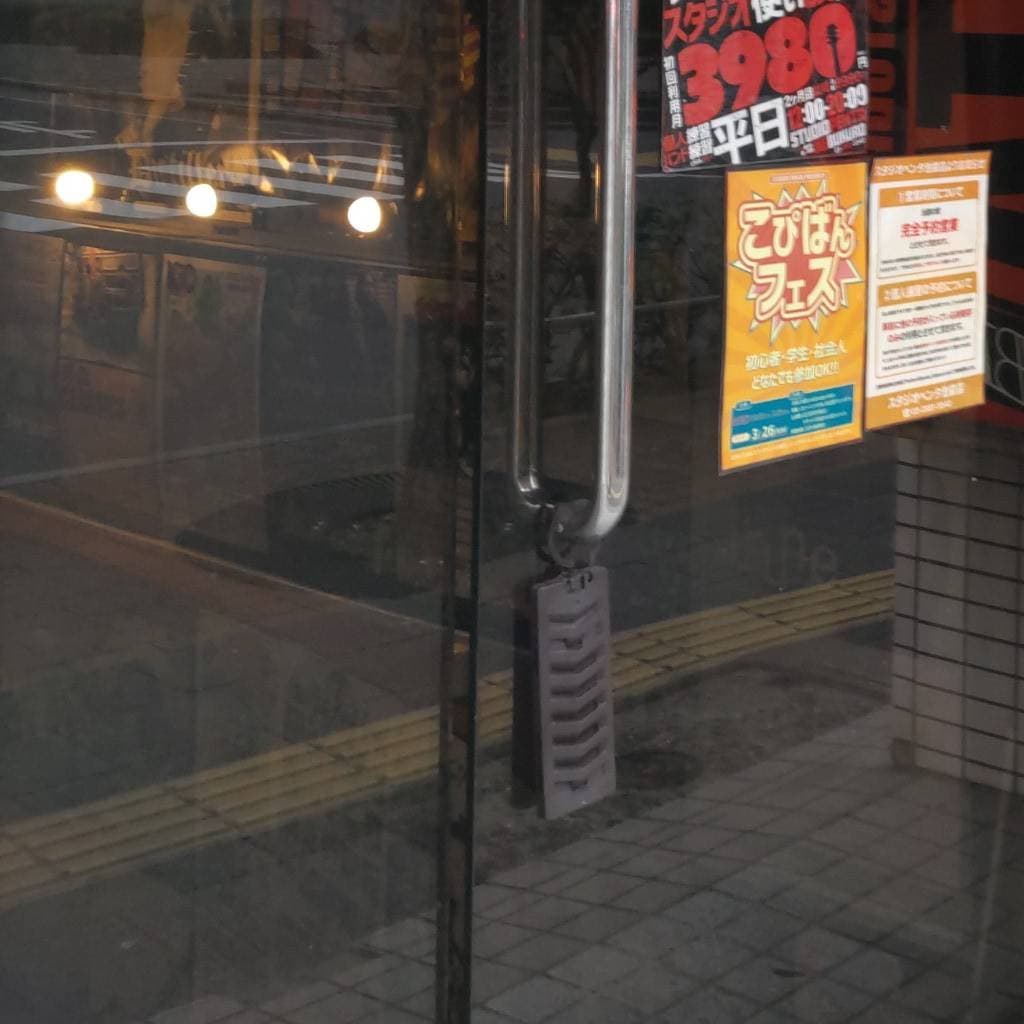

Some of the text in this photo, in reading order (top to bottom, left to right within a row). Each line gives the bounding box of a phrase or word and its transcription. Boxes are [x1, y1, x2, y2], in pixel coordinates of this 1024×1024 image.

[677, 2, 857, 126] 3980
[711, 97, 790, 165] 平日
[741, 197, 854, 259] こぴばん
[754, 255, 837, 314] フェス
